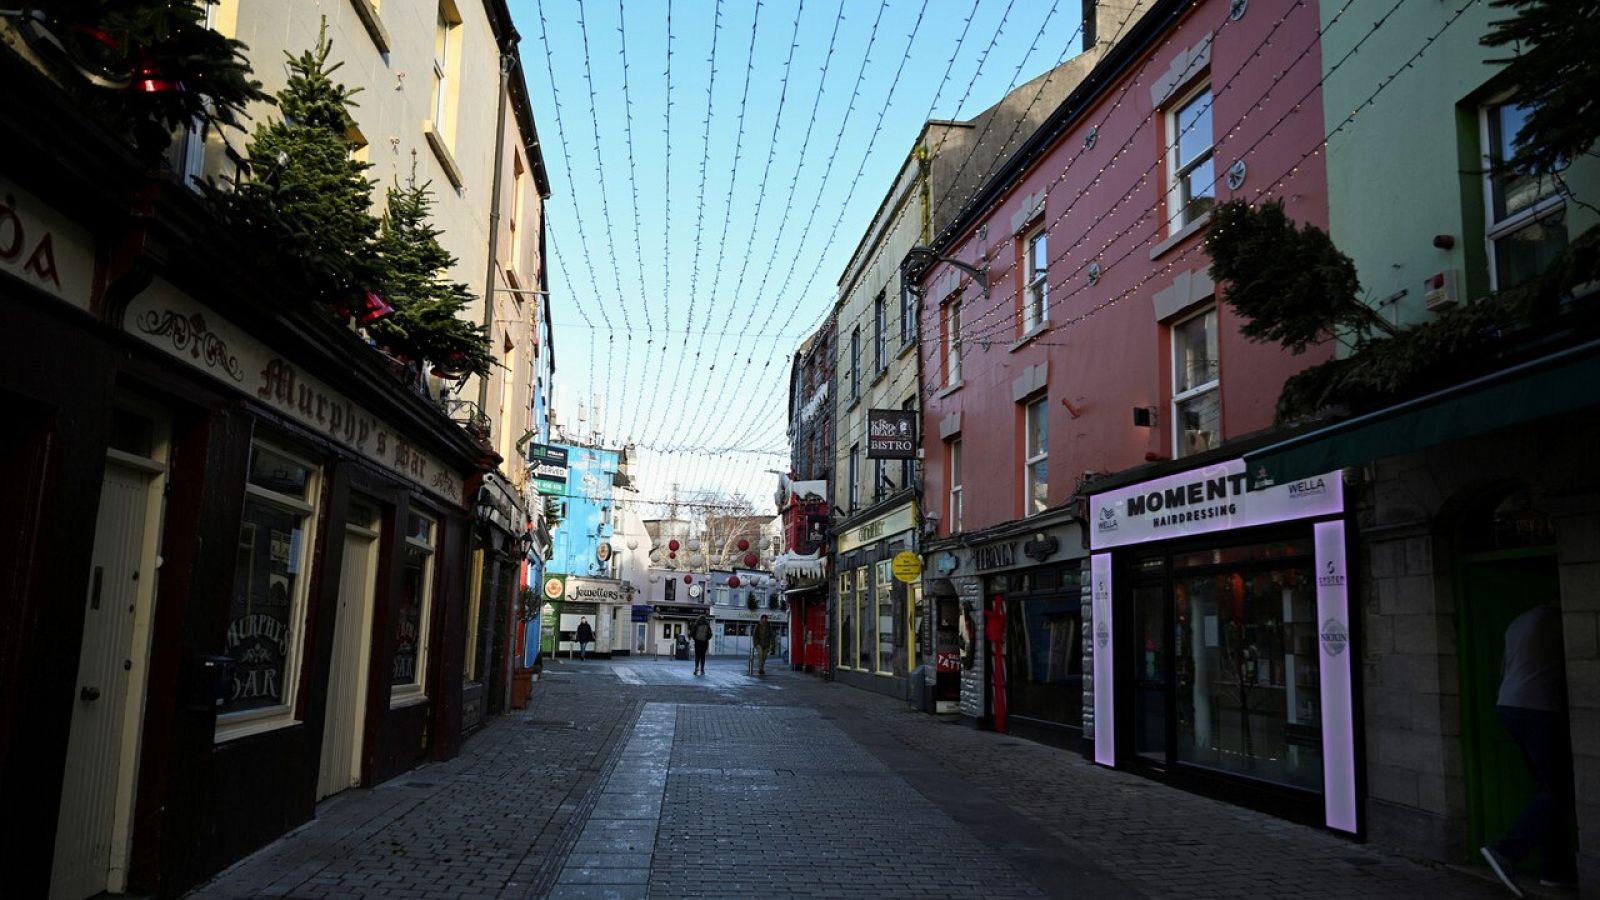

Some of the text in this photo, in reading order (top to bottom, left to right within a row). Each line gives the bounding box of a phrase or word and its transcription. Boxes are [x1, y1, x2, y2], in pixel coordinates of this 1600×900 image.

[258, 360, 426, 478] Murphy's Bar
[871, 440, 912, 450] BISTRO
[1288, 478, 1326, 494] WELLA
[1153, 503, 1237, 528] HAIRDRESSING
